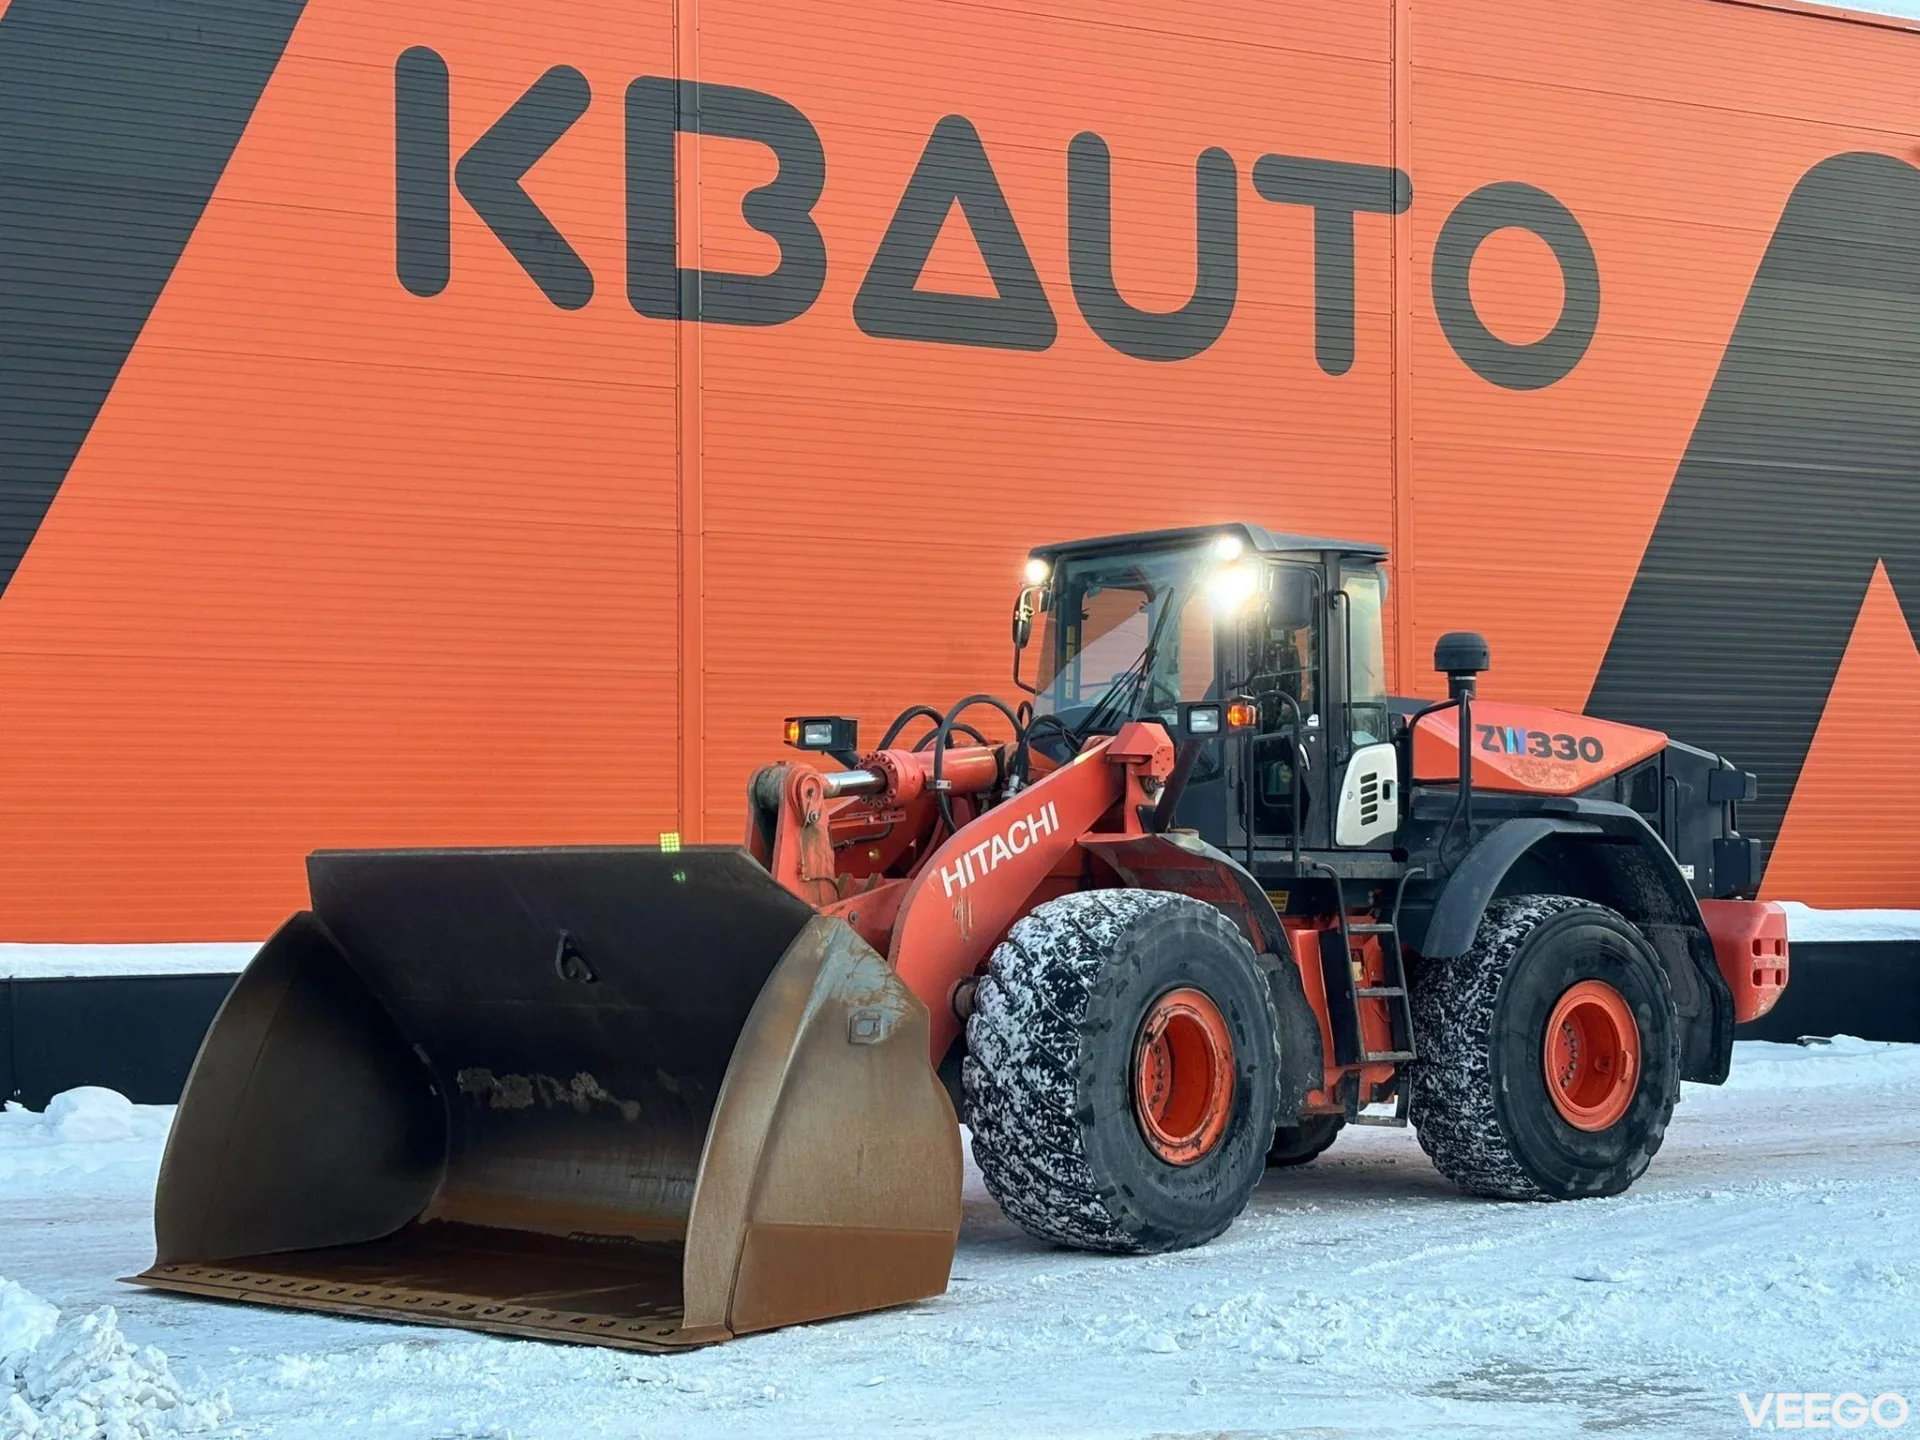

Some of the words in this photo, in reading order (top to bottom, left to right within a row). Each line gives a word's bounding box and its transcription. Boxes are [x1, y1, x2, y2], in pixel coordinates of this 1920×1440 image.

[395, 46, 1601, 391] KBAUTO
[1475, 723, 1604, 764] ZW330
[940, 800, 1060, 898] HITACHI
